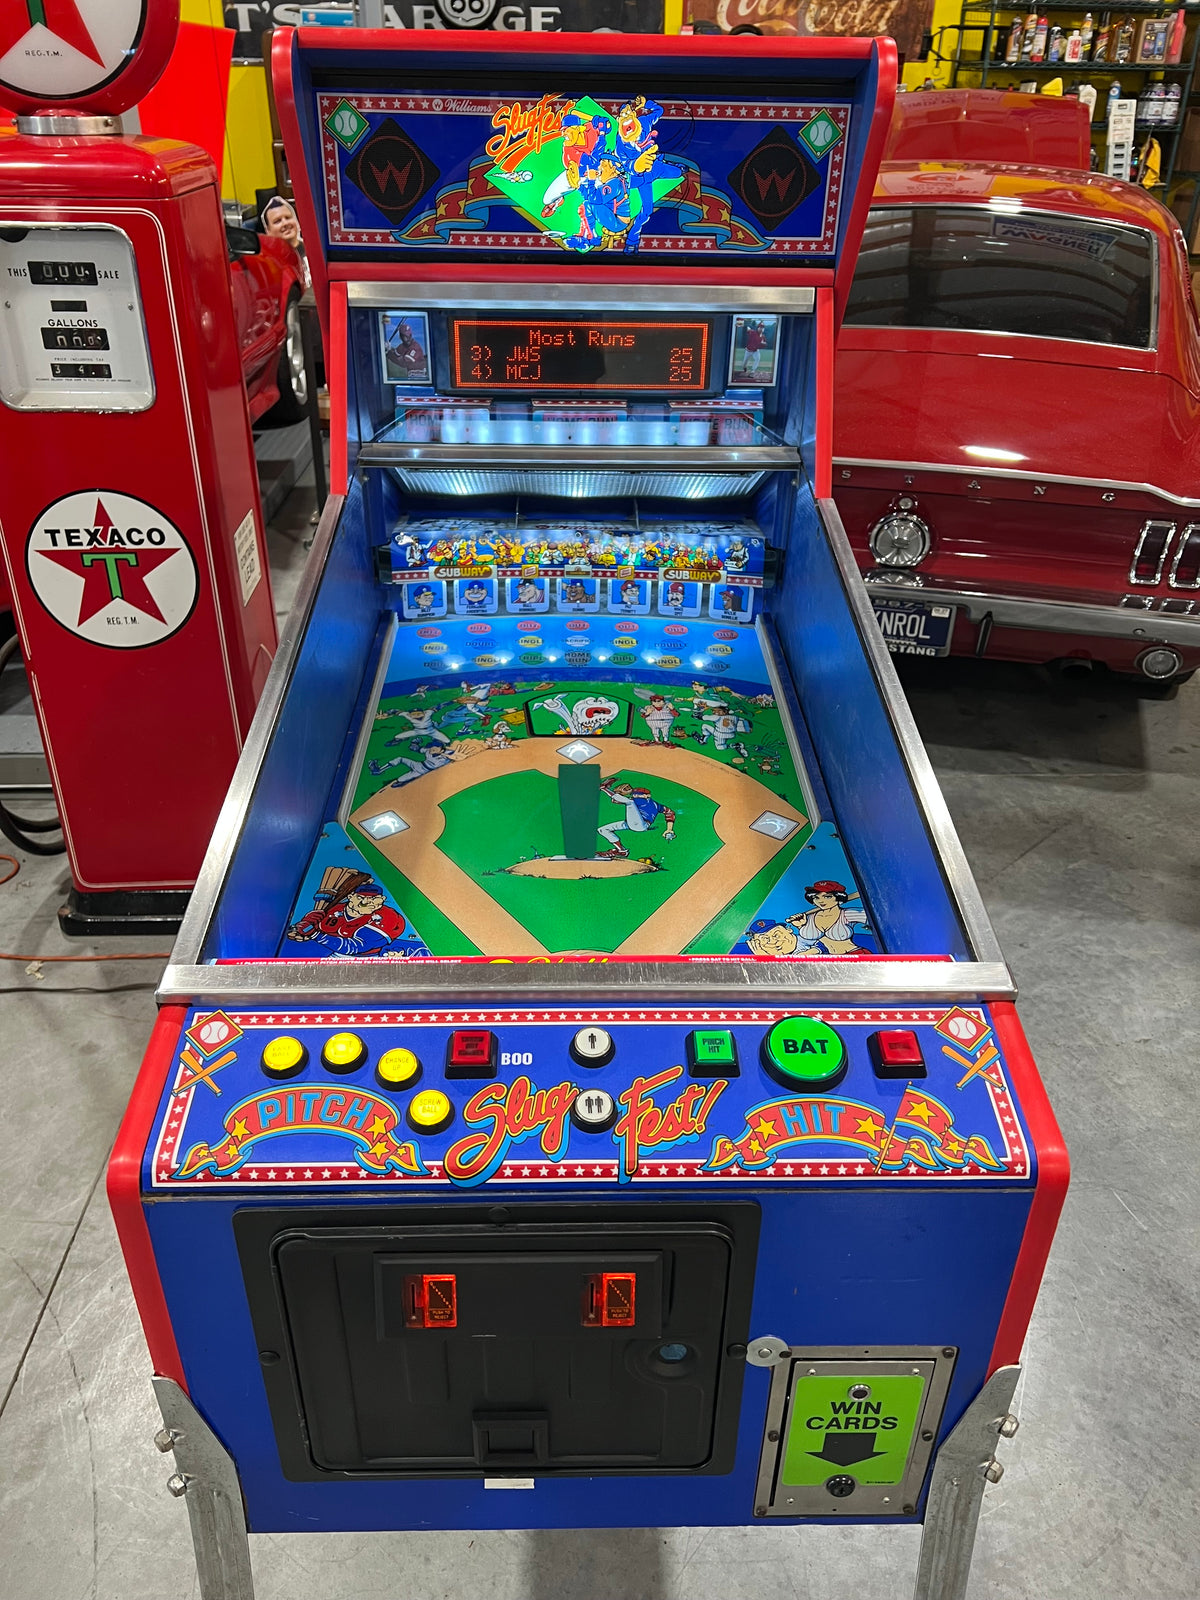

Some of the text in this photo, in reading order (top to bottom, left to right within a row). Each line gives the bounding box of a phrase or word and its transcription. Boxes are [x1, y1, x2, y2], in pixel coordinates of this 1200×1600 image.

[445, 99, 492, 112] Williams
[8, 268, 119, 279] THIS SALE
[48, 319, 98, 327] GALLONS
[529, 329, 635, 347] Most Runs
[470, 345, 693, 363] 3) JWS 25
[471, 364, 692, 381] 4) MCJ 25
[44, 528, 166, 547] TEXACO
[435, 566, 491, 578] SUBWAY
[665, 570, 720, 581] SUBWAY
[888, 644, 937, 657] STANG
[708, 1045, 720, 1053] HIT
[782, 1038, 829, 1054] BAT
[501, 1052, 533, 1066] BOO
[257, 1092, 374, 1130] PITCH
[780, 1103, 847, 1137] HIT
[443, 1075, 580, 1184] Slug
[830, 1401, 882, 1414] WIN
[805, 1416, 898, 1430] CARDS
